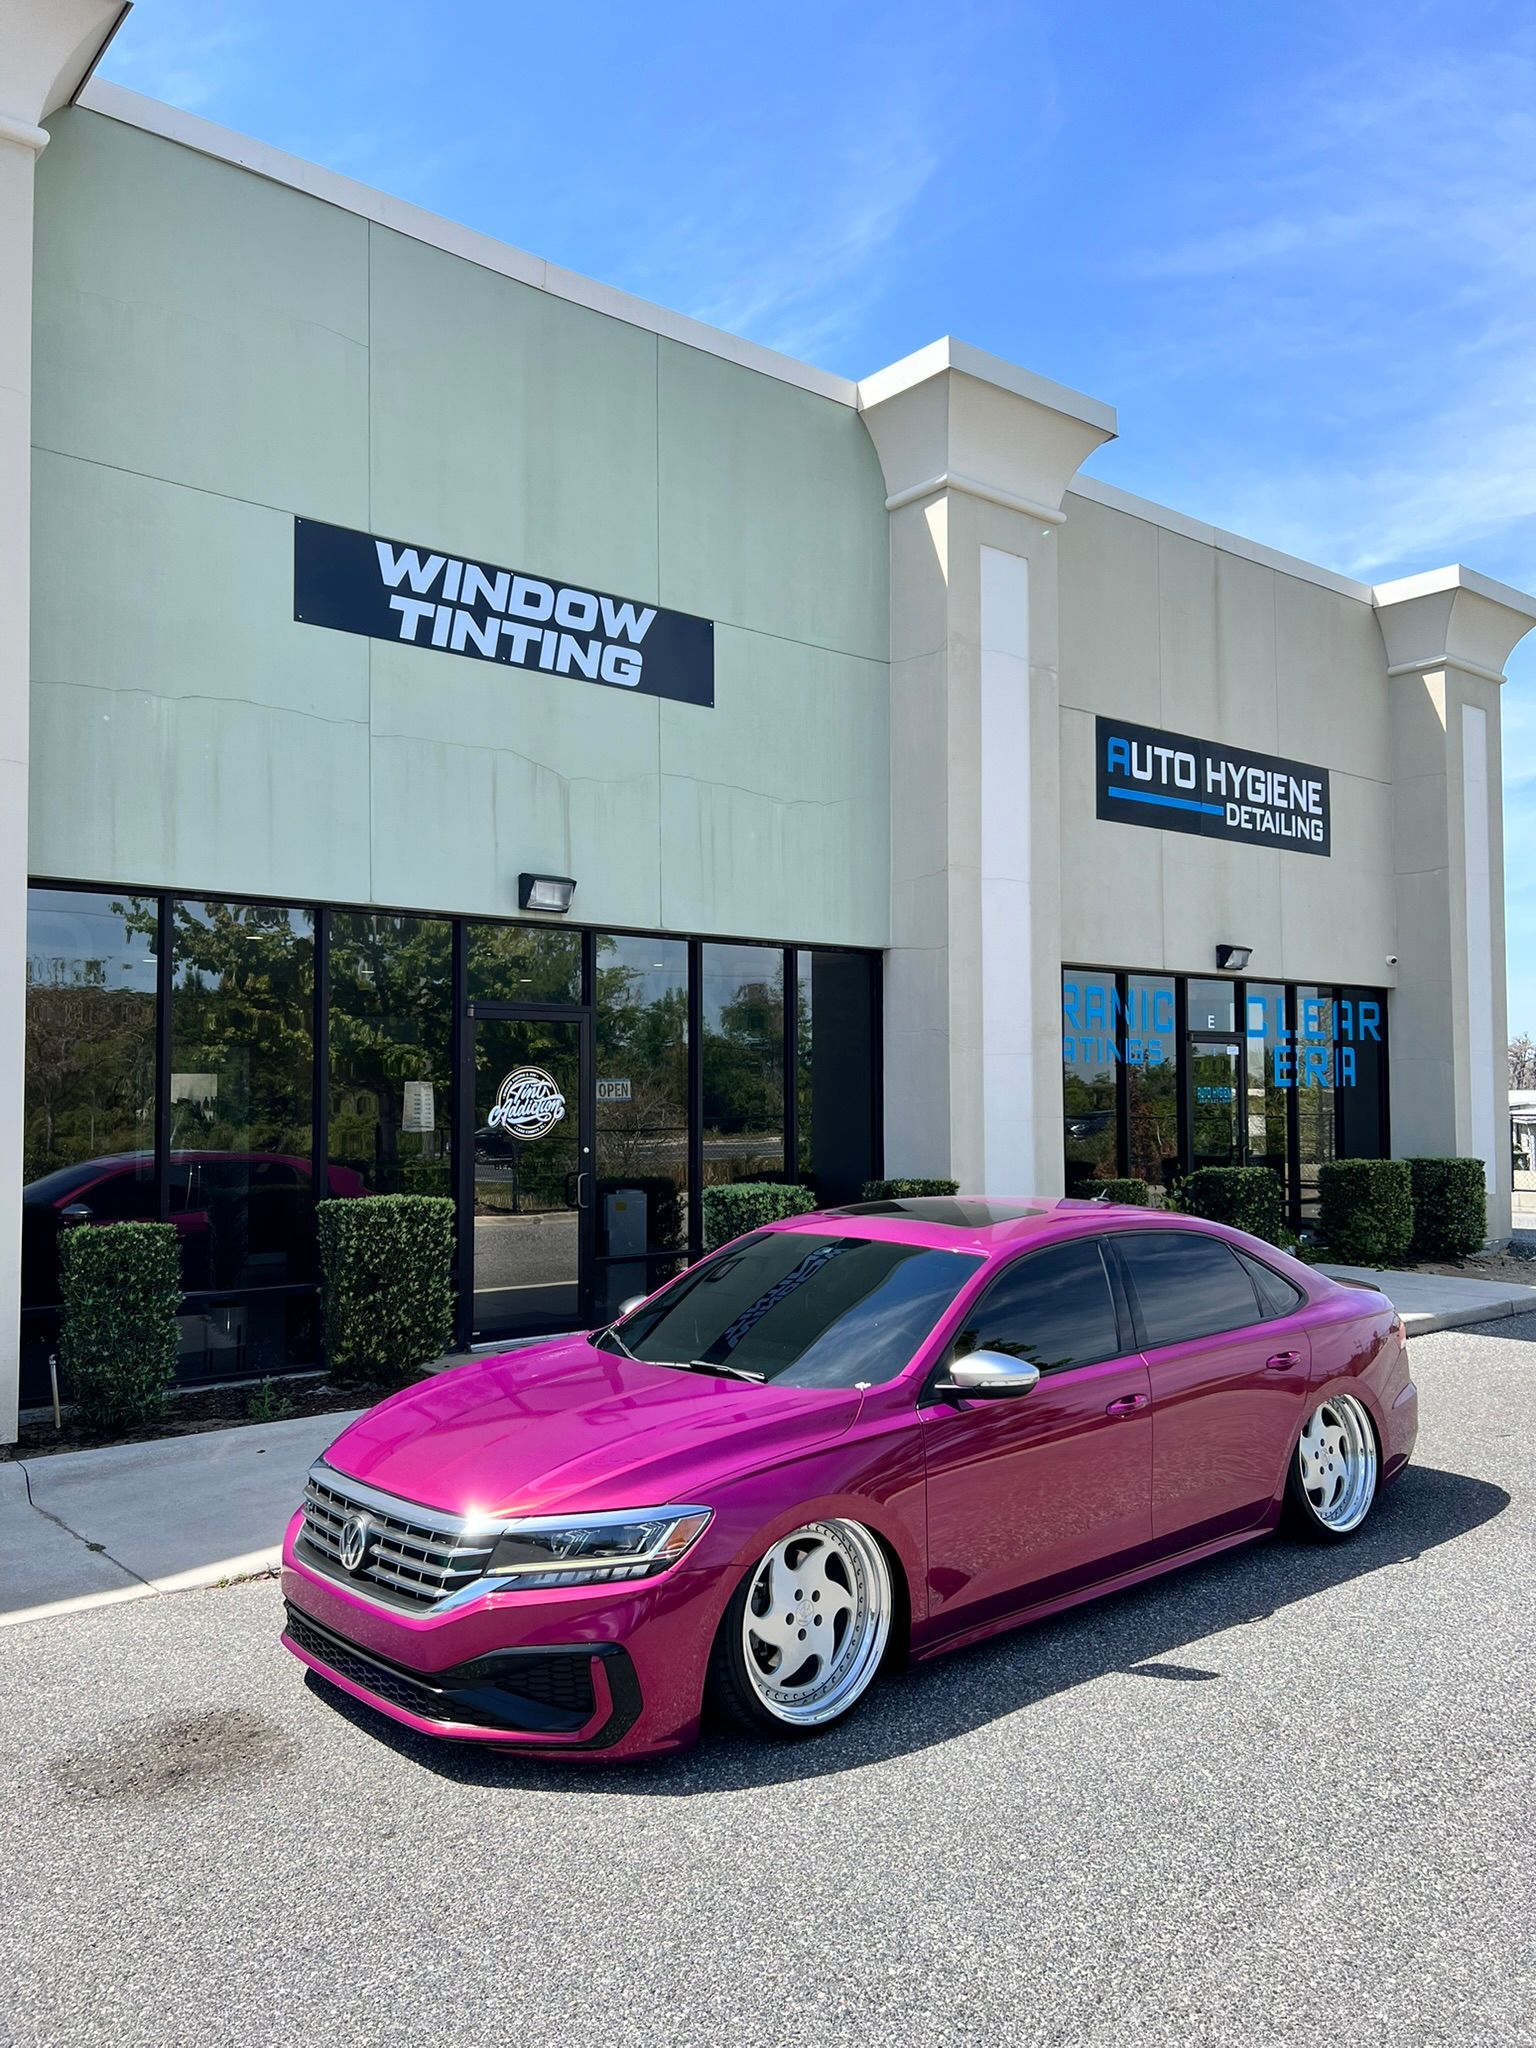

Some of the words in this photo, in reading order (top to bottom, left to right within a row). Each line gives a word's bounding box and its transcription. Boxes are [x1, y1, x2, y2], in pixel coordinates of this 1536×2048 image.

[375, 540, 658, 644] WINDOW
[389, 594, 643, 687] TINTING
[1107, 736, 1196, 790] AUTO
[1206, 758, 1323, 816] HYGIENE
[1226, 802, 1324, 842] DETAILING
[1207, 1014, 1215, 1029] E
[509, 1079, 552, 1105] Tint
[598, 1083, 629, 1098] OPEN
[488, 1093, 566, 1128] Addiction
